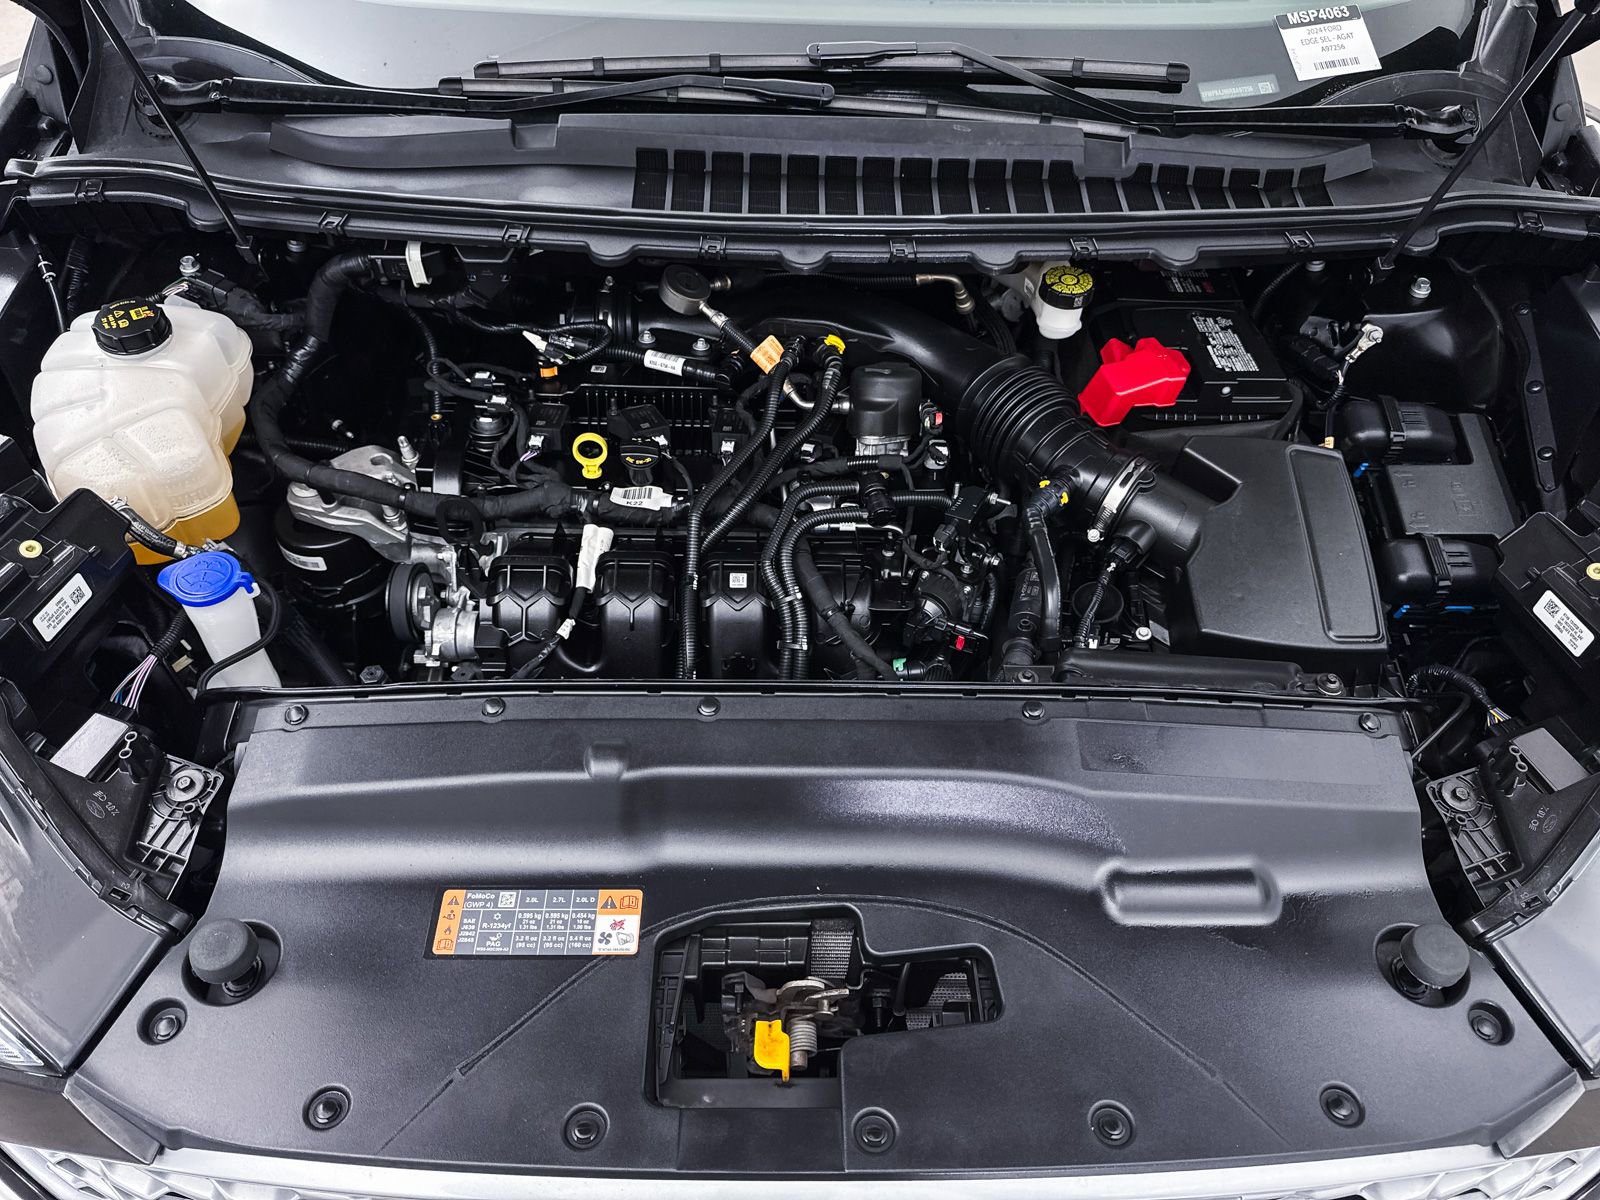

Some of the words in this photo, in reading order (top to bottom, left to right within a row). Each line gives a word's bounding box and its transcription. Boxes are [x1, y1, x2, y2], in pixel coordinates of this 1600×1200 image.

[1287, 6, 1350, 24] MSP4063
[1306, 27, 1323, 35] 2024
[1324, 24, 1342, 33] FORD
[1300, 38, 1319, 46] EDGE
[1320, 36, 1332, 44] SEL
[1336, 32, 1354, 40] AGAT
[1321, 44, 1346, 53] A97256
[467, 892, 496, 900] FoMoCo
[534, 912, 542, 920] kg
[562, 912, 568, 920] kg
[588, 912, 596, 920] kg
[482, 922, 512, 930] R-1234yf
